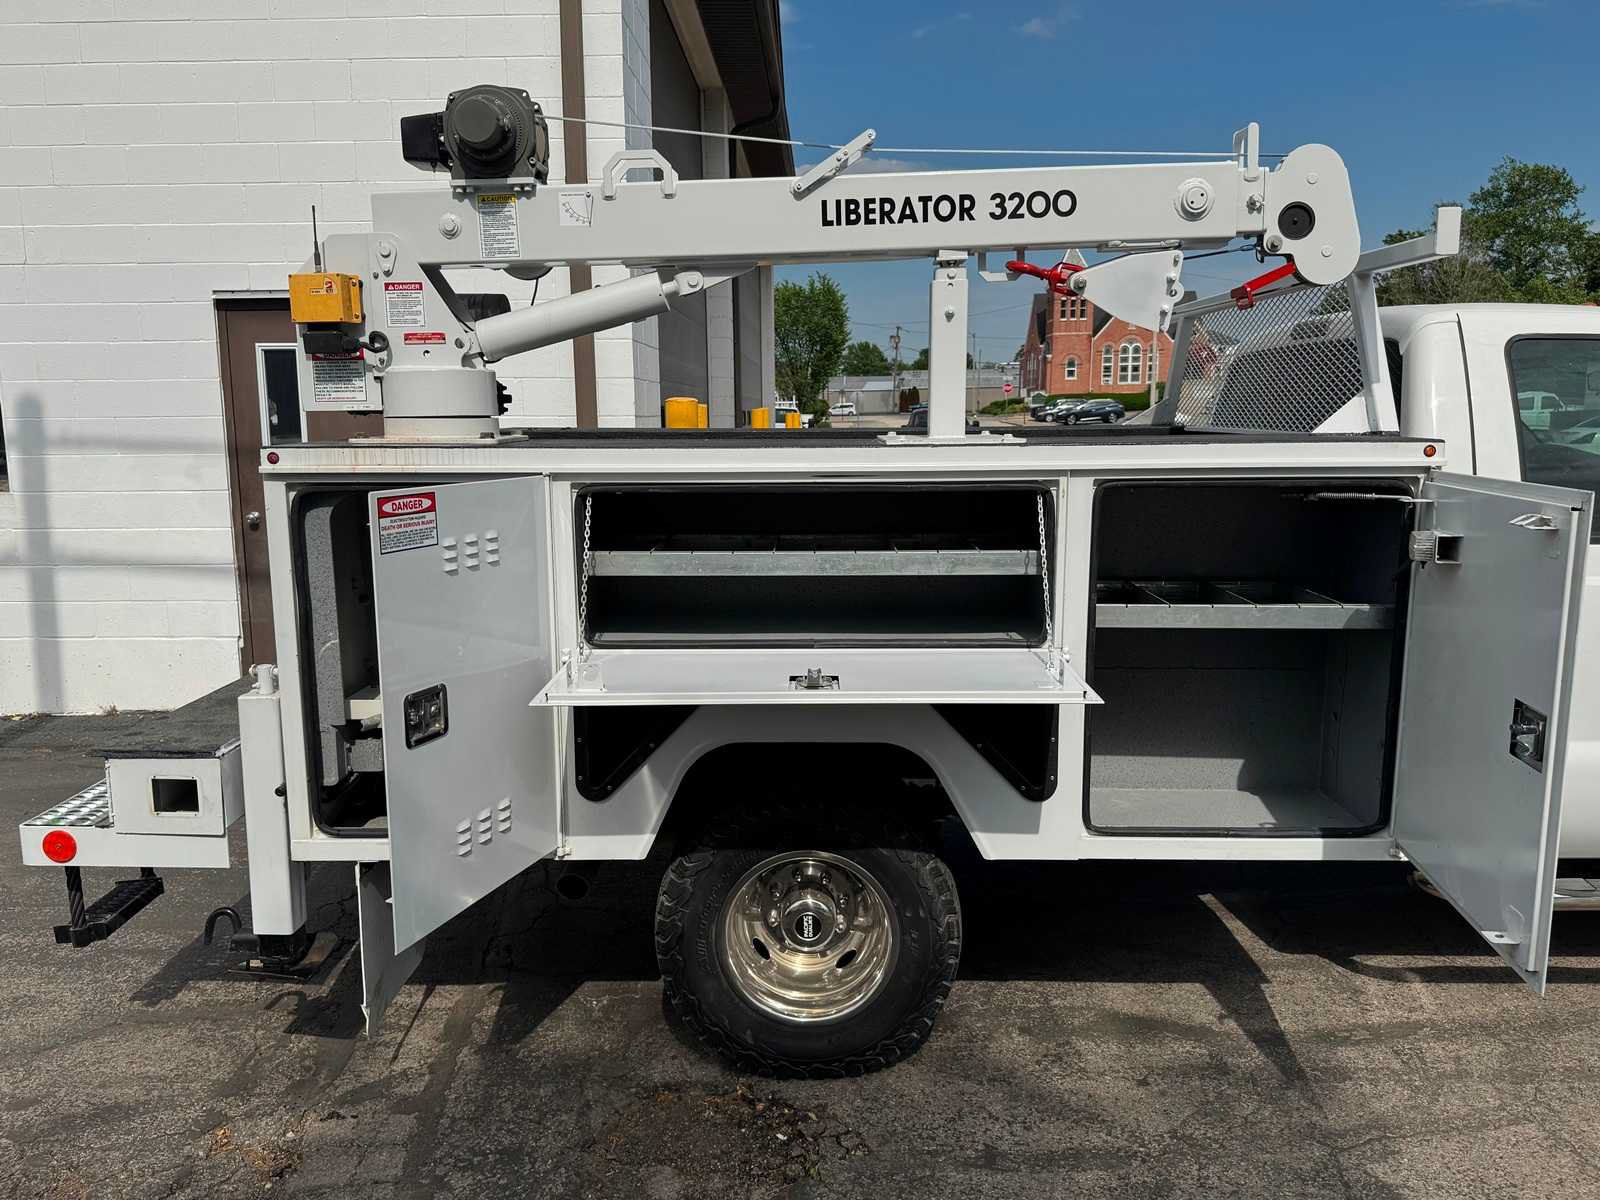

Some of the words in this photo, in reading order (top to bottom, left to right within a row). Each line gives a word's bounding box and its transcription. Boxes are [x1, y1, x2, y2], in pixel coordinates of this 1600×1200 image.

[821, 194, 976, 227] LIBERATOR
[988, 189, 1077, 220] 3200
[391, 500, 423, 512] DANGER
